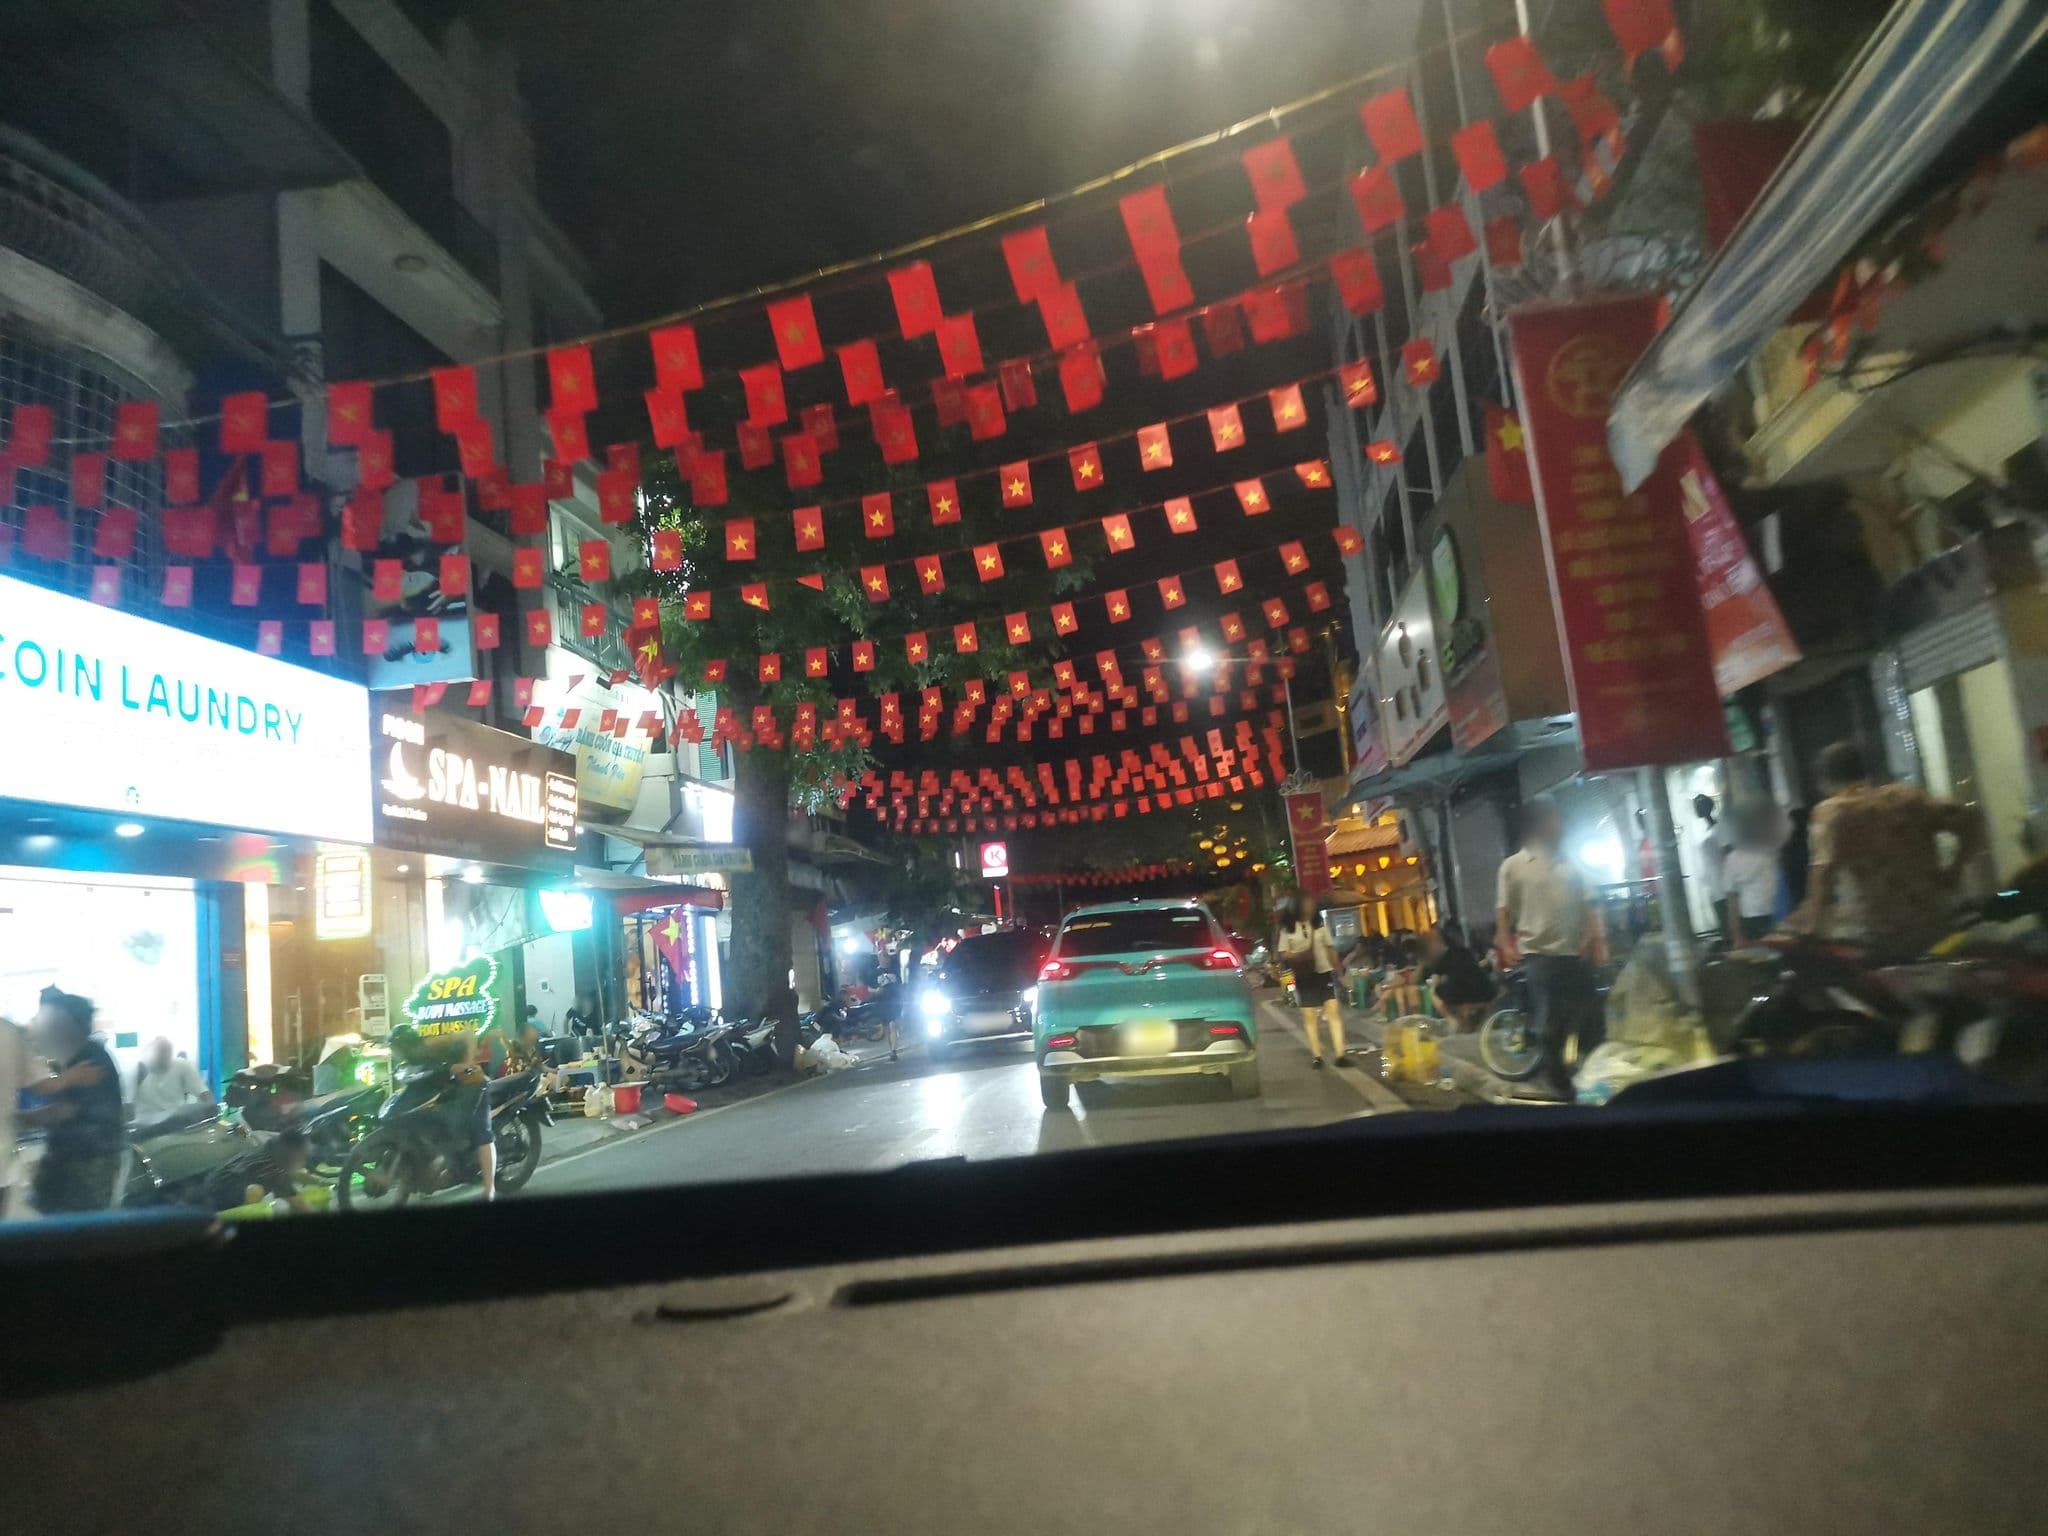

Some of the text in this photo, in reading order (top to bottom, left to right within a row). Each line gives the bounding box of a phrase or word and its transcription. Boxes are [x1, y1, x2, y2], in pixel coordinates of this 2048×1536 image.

[0, 634, 101, 701] OIN
[122, 664, 302, 744] LAUNDRY
[428, 975, 476, 1000] SPA
[445, 1000, 488, 1016] MASSAGE
